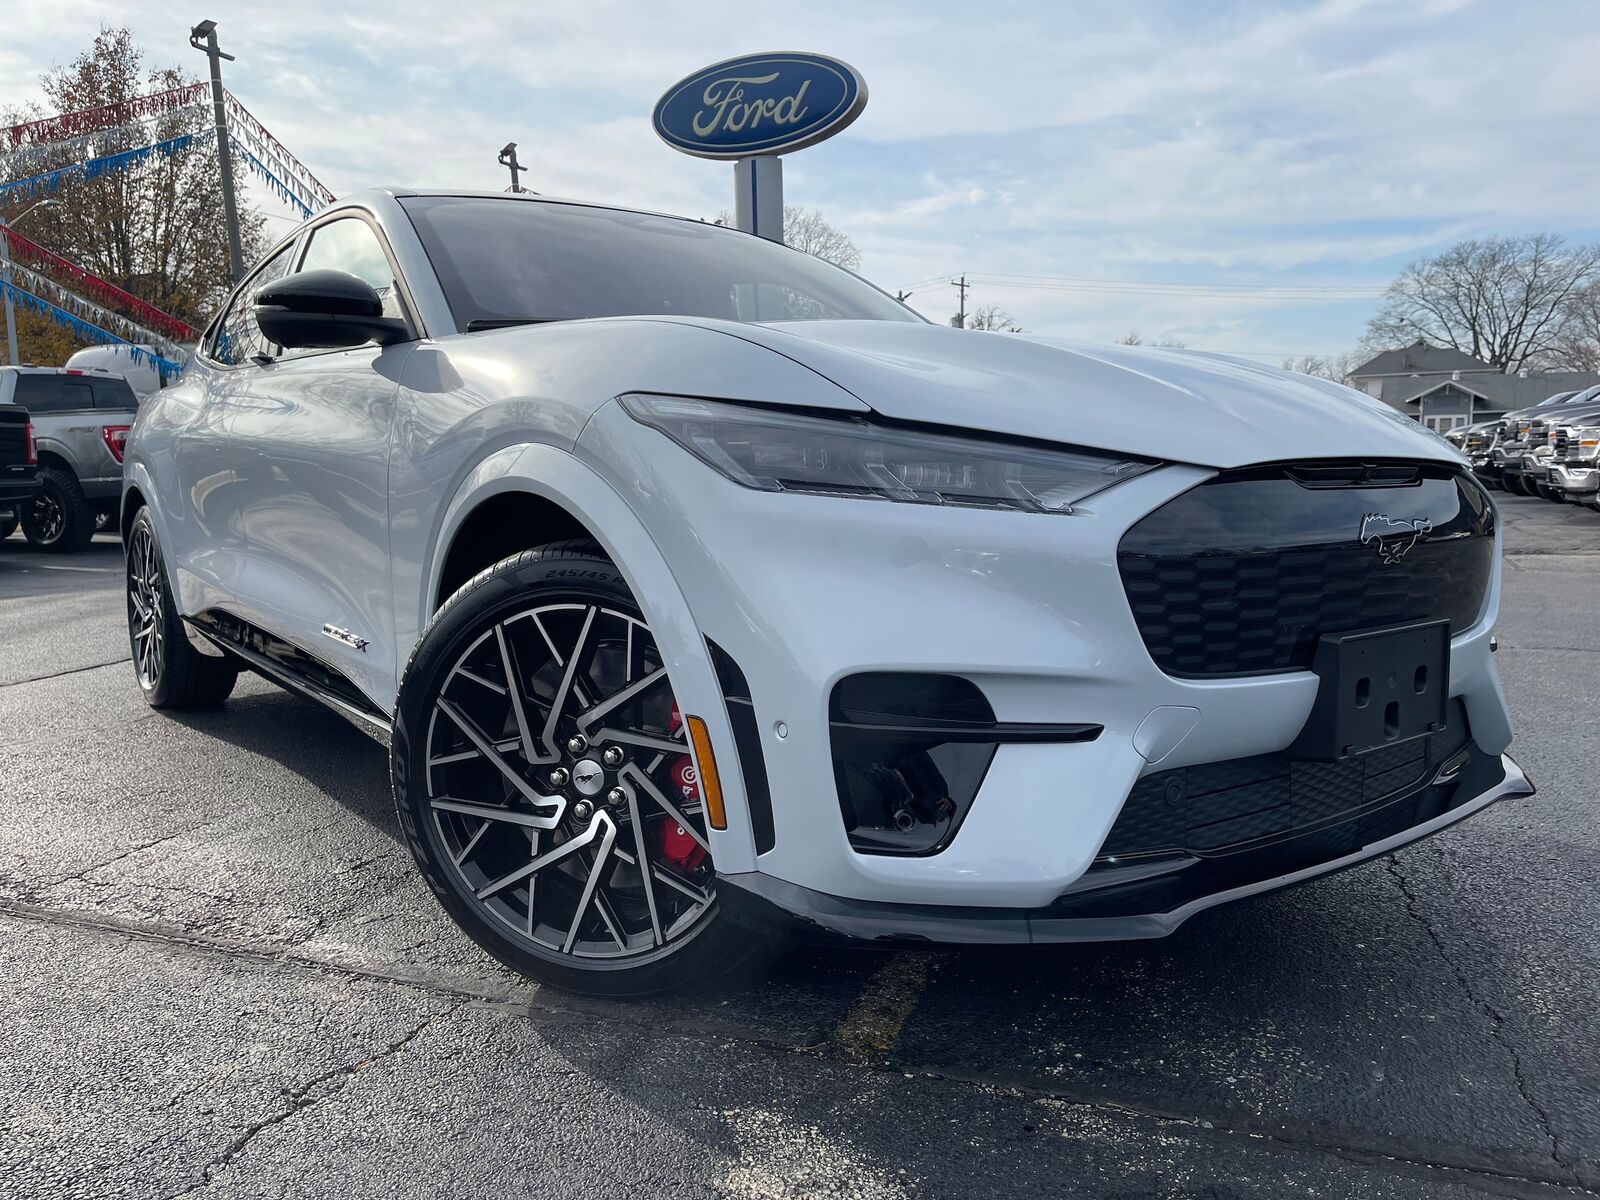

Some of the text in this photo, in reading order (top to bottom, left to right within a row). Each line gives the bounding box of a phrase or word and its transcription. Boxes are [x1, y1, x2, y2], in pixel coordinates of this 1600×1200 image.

[693, 72, 811, 137] Ford
[545, 568, 609, 580] 245/45
[396, 753, 428, 864] ZERO
